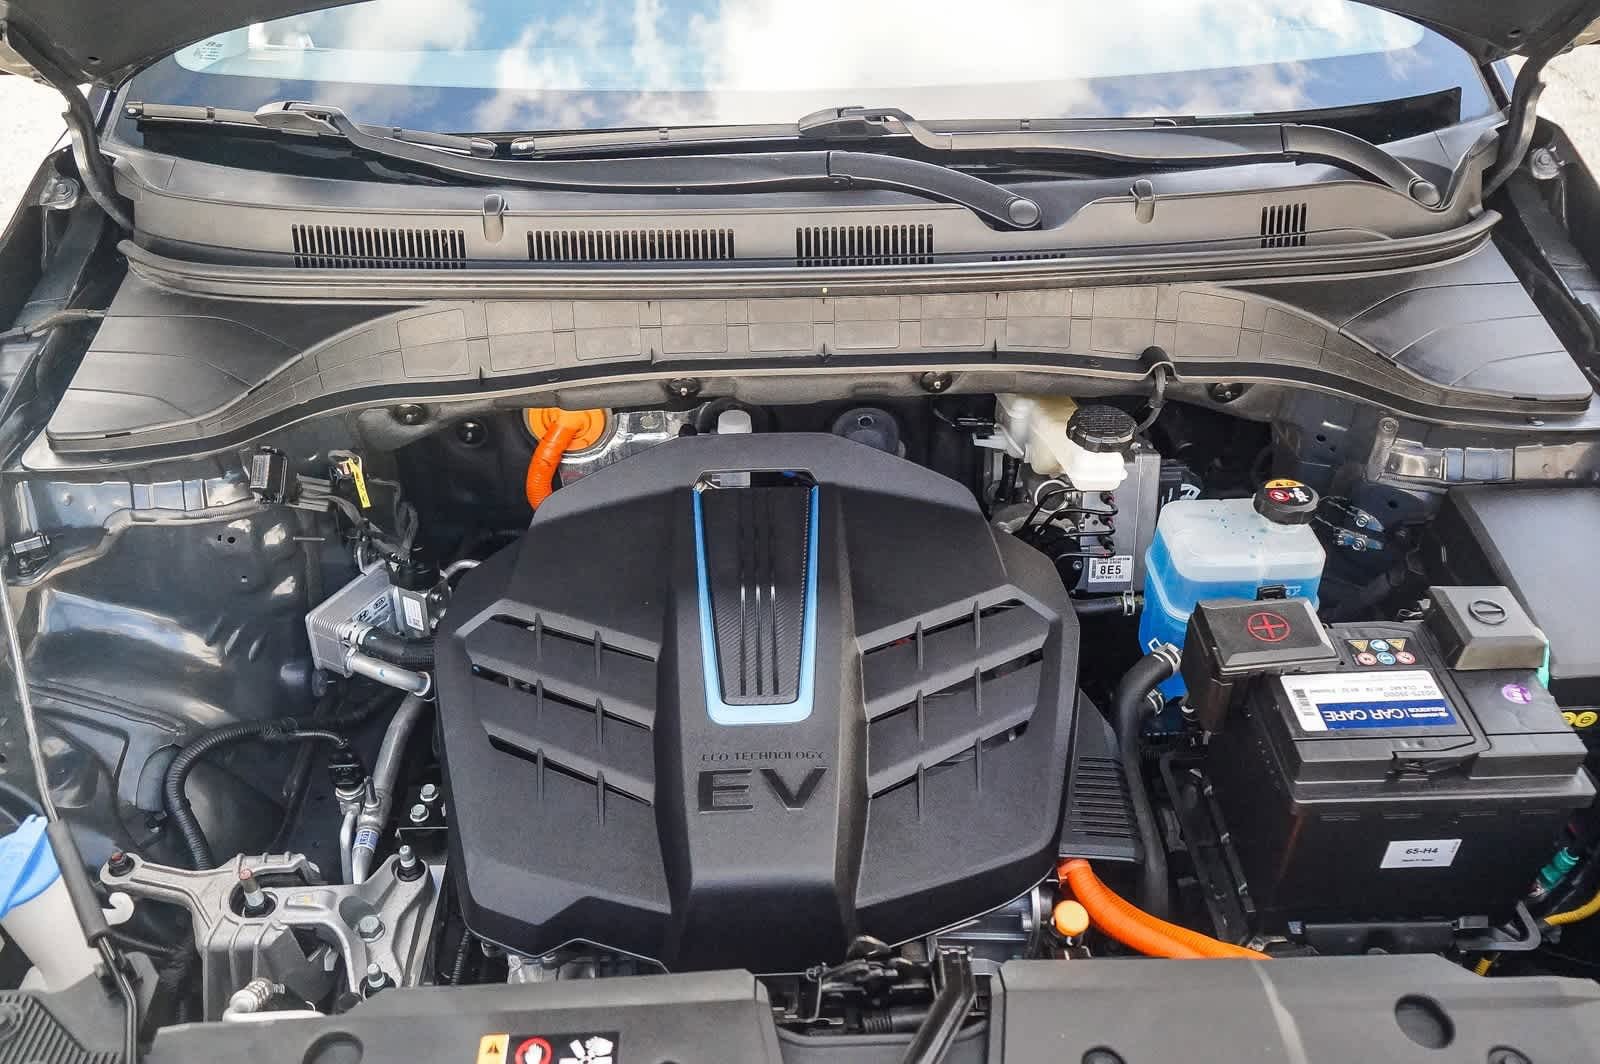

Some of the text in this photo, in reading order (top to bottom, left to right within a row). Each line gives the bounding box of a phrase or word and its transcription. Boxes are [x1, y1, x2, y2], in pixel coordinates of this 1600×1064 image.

[1100, 565, 1121, 575] 8E5
[1324, 710, 1367, 721] CARE
[1370, 708, 1404, 720] CAR
[701, 751, 824, 761] ECO TECHNOLOGY
[698, 767, 828, 814] EV
